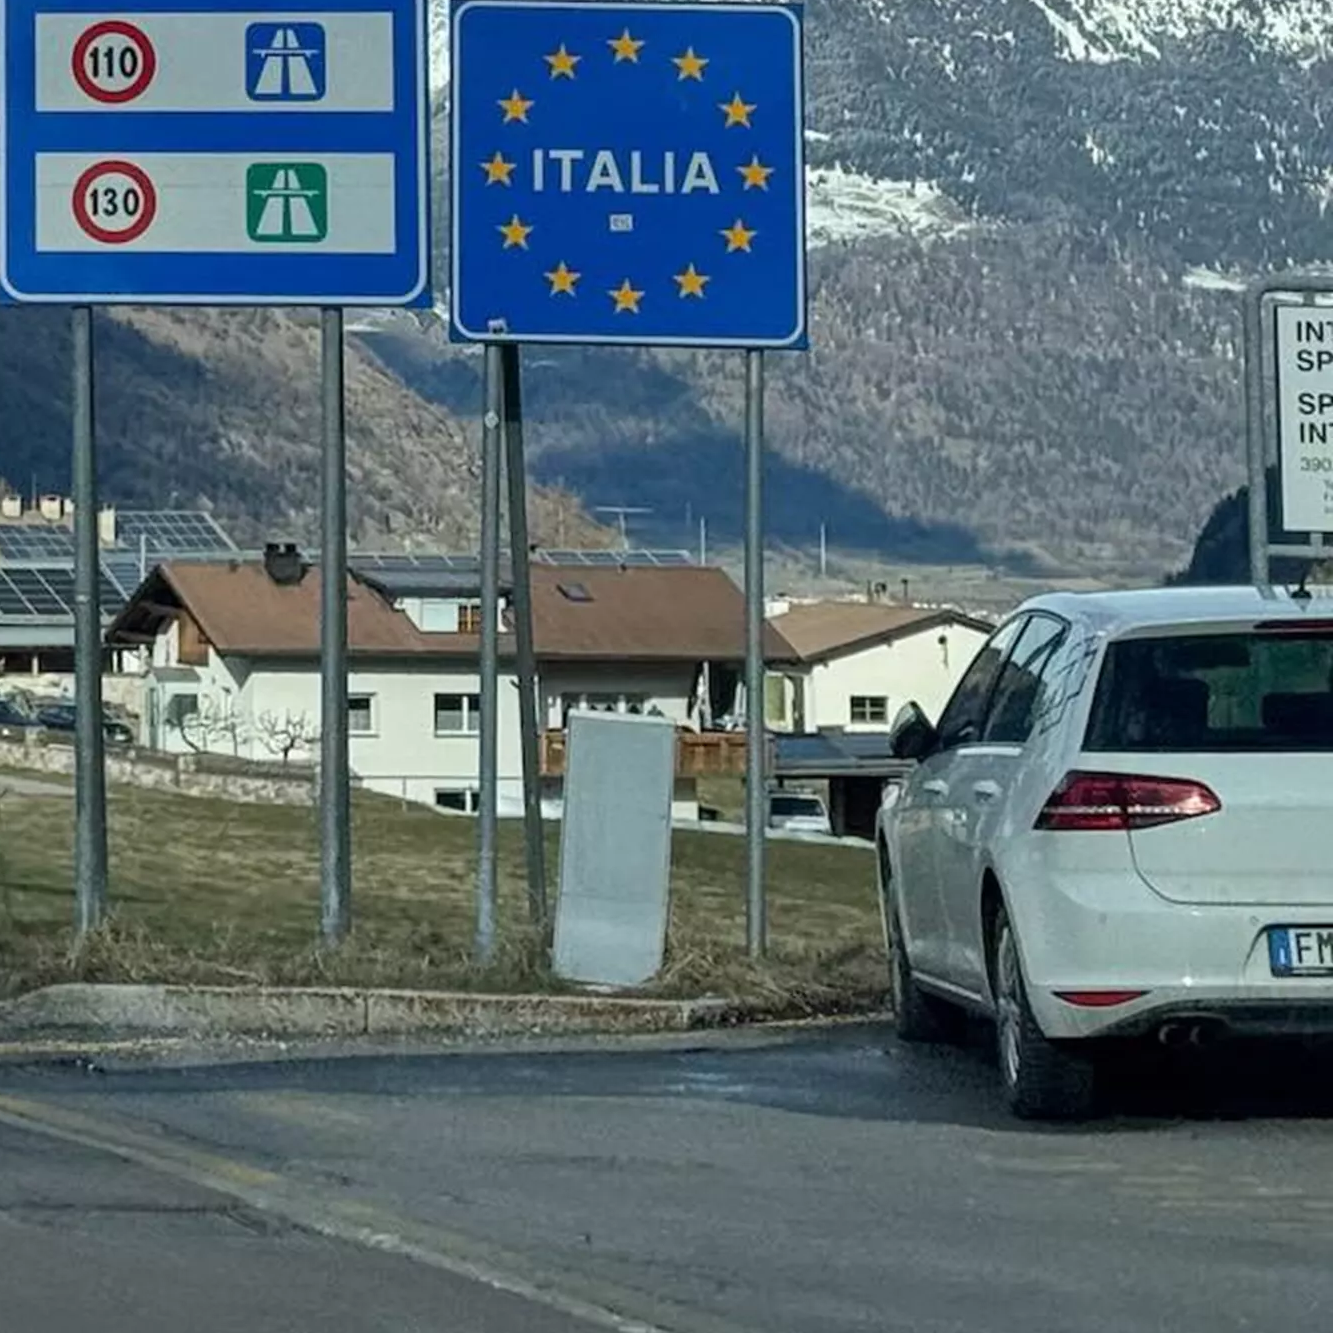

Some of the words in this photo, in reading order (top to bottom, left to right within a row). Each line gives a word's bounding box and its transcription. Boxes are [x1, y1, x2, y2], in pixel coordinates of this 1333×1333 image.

[89, 46, 138, 79] 110
[533, 149, 720, 194] ITALIA
[90, 187, 140, 217] 130
[1296, 349, 1333, 372] SP
[1297, 392, 1333, 415] SP
